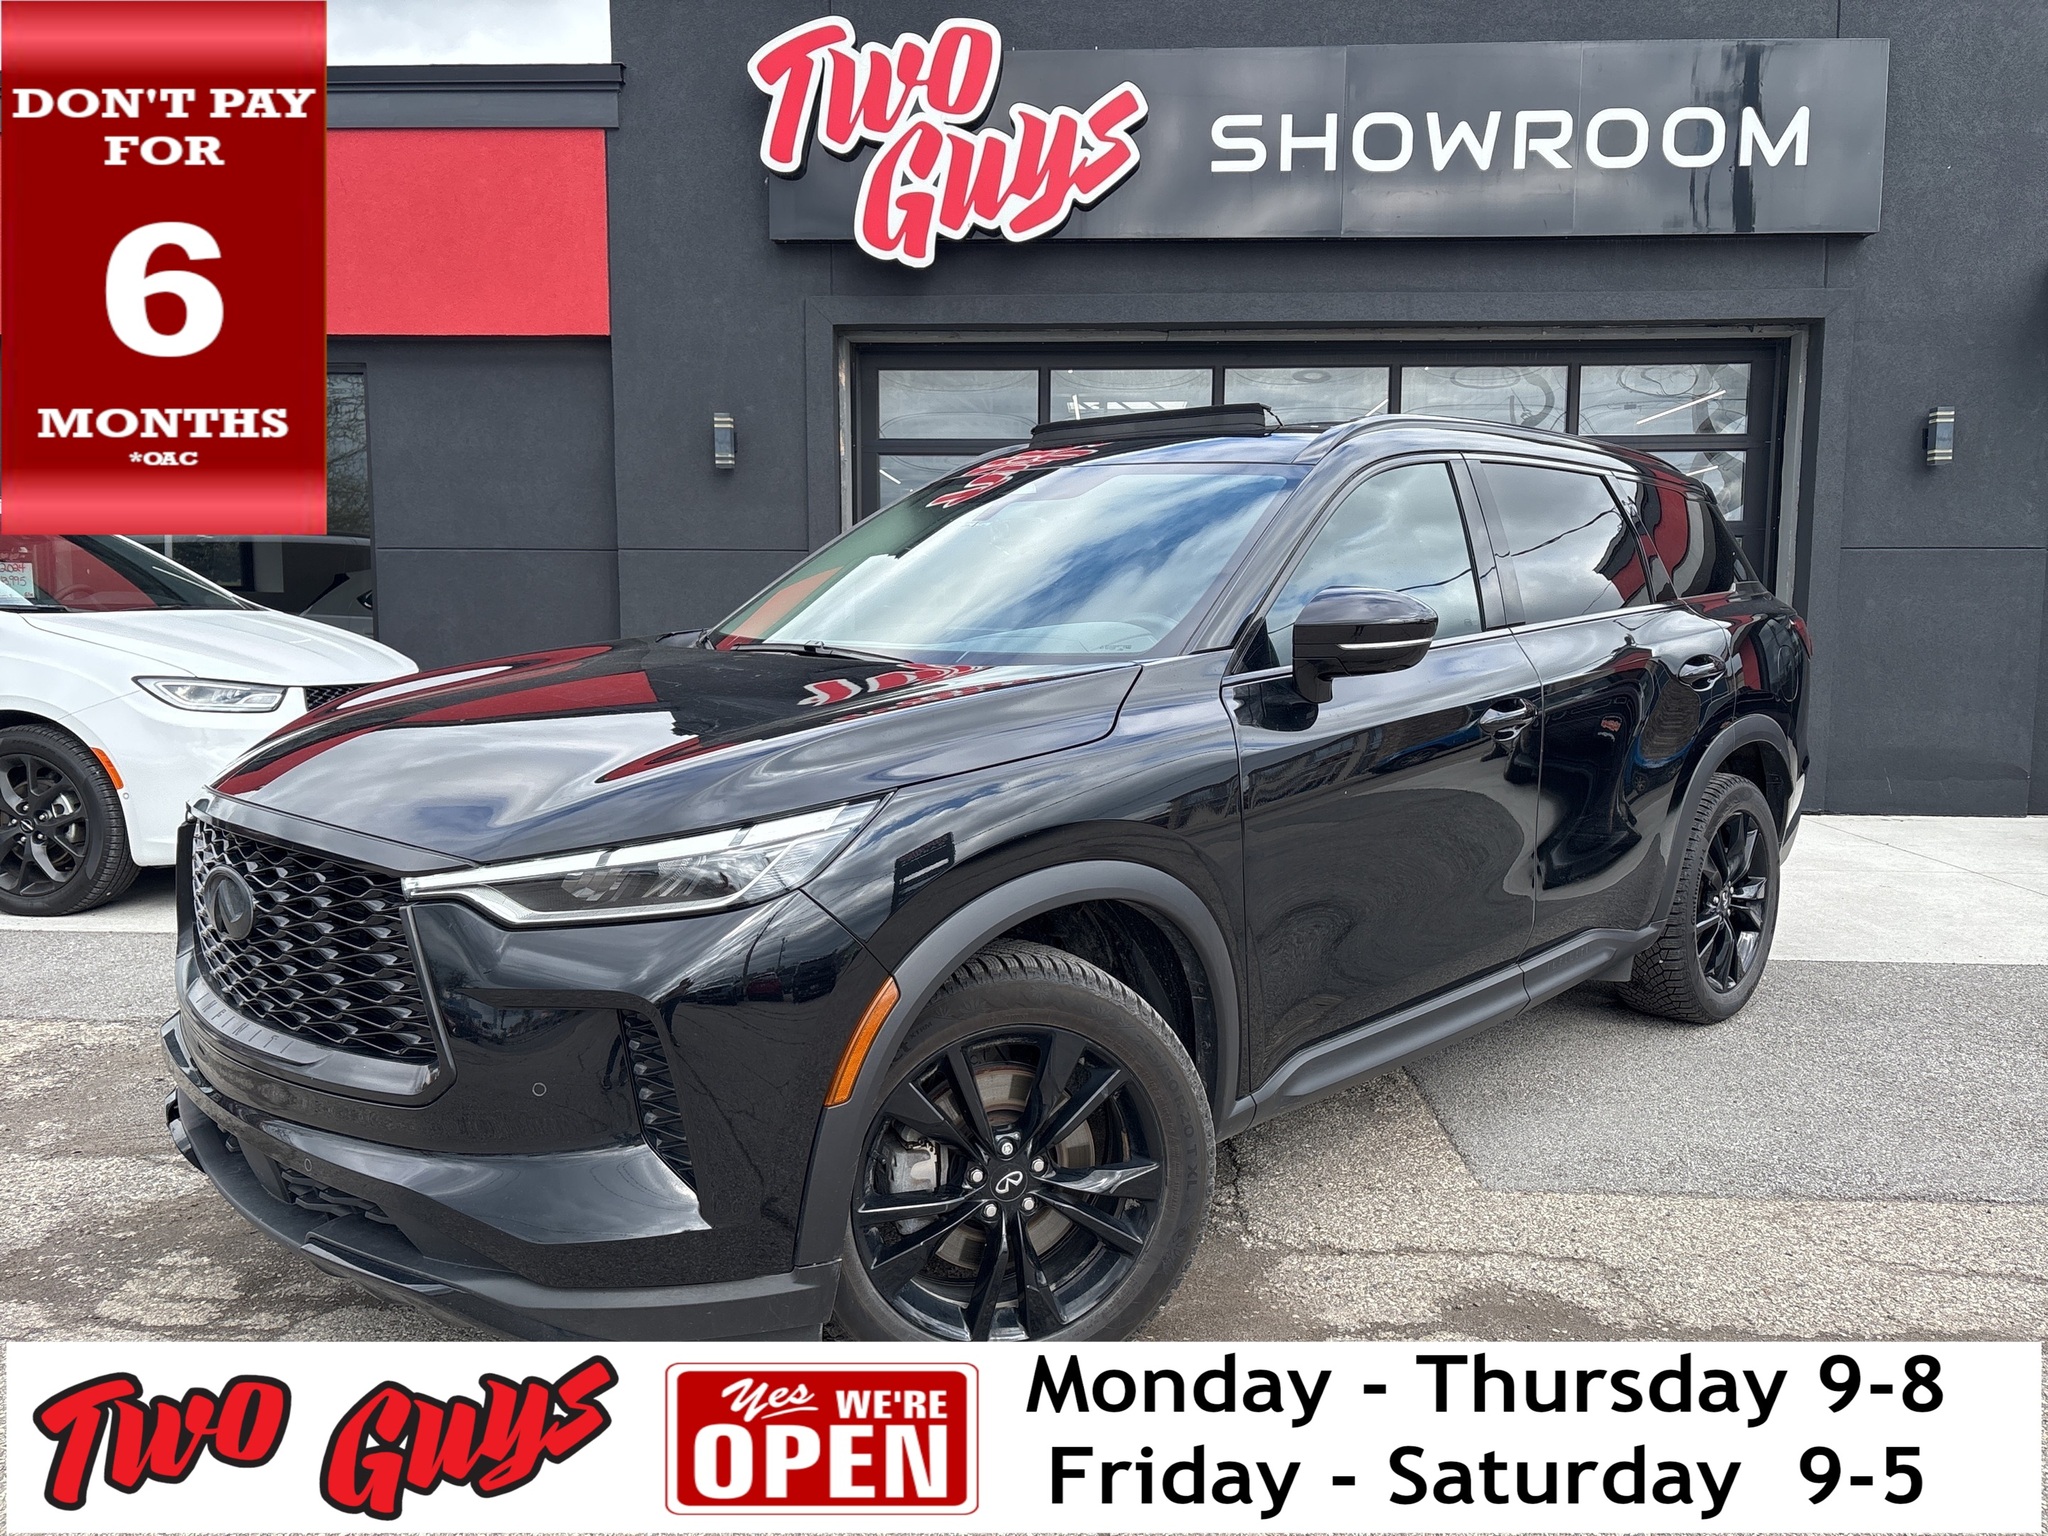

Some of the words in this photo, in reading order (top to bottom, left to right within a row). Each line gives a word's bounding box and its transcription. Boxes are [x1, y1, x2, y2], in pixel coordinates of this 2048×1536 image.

[751, 19, 998, 168] Two
[1210, 105, 1810, 173] SHOWROOM
[857, 84, 1146, 264] Guys
[195, 992, 295, 1054] INFINITI
